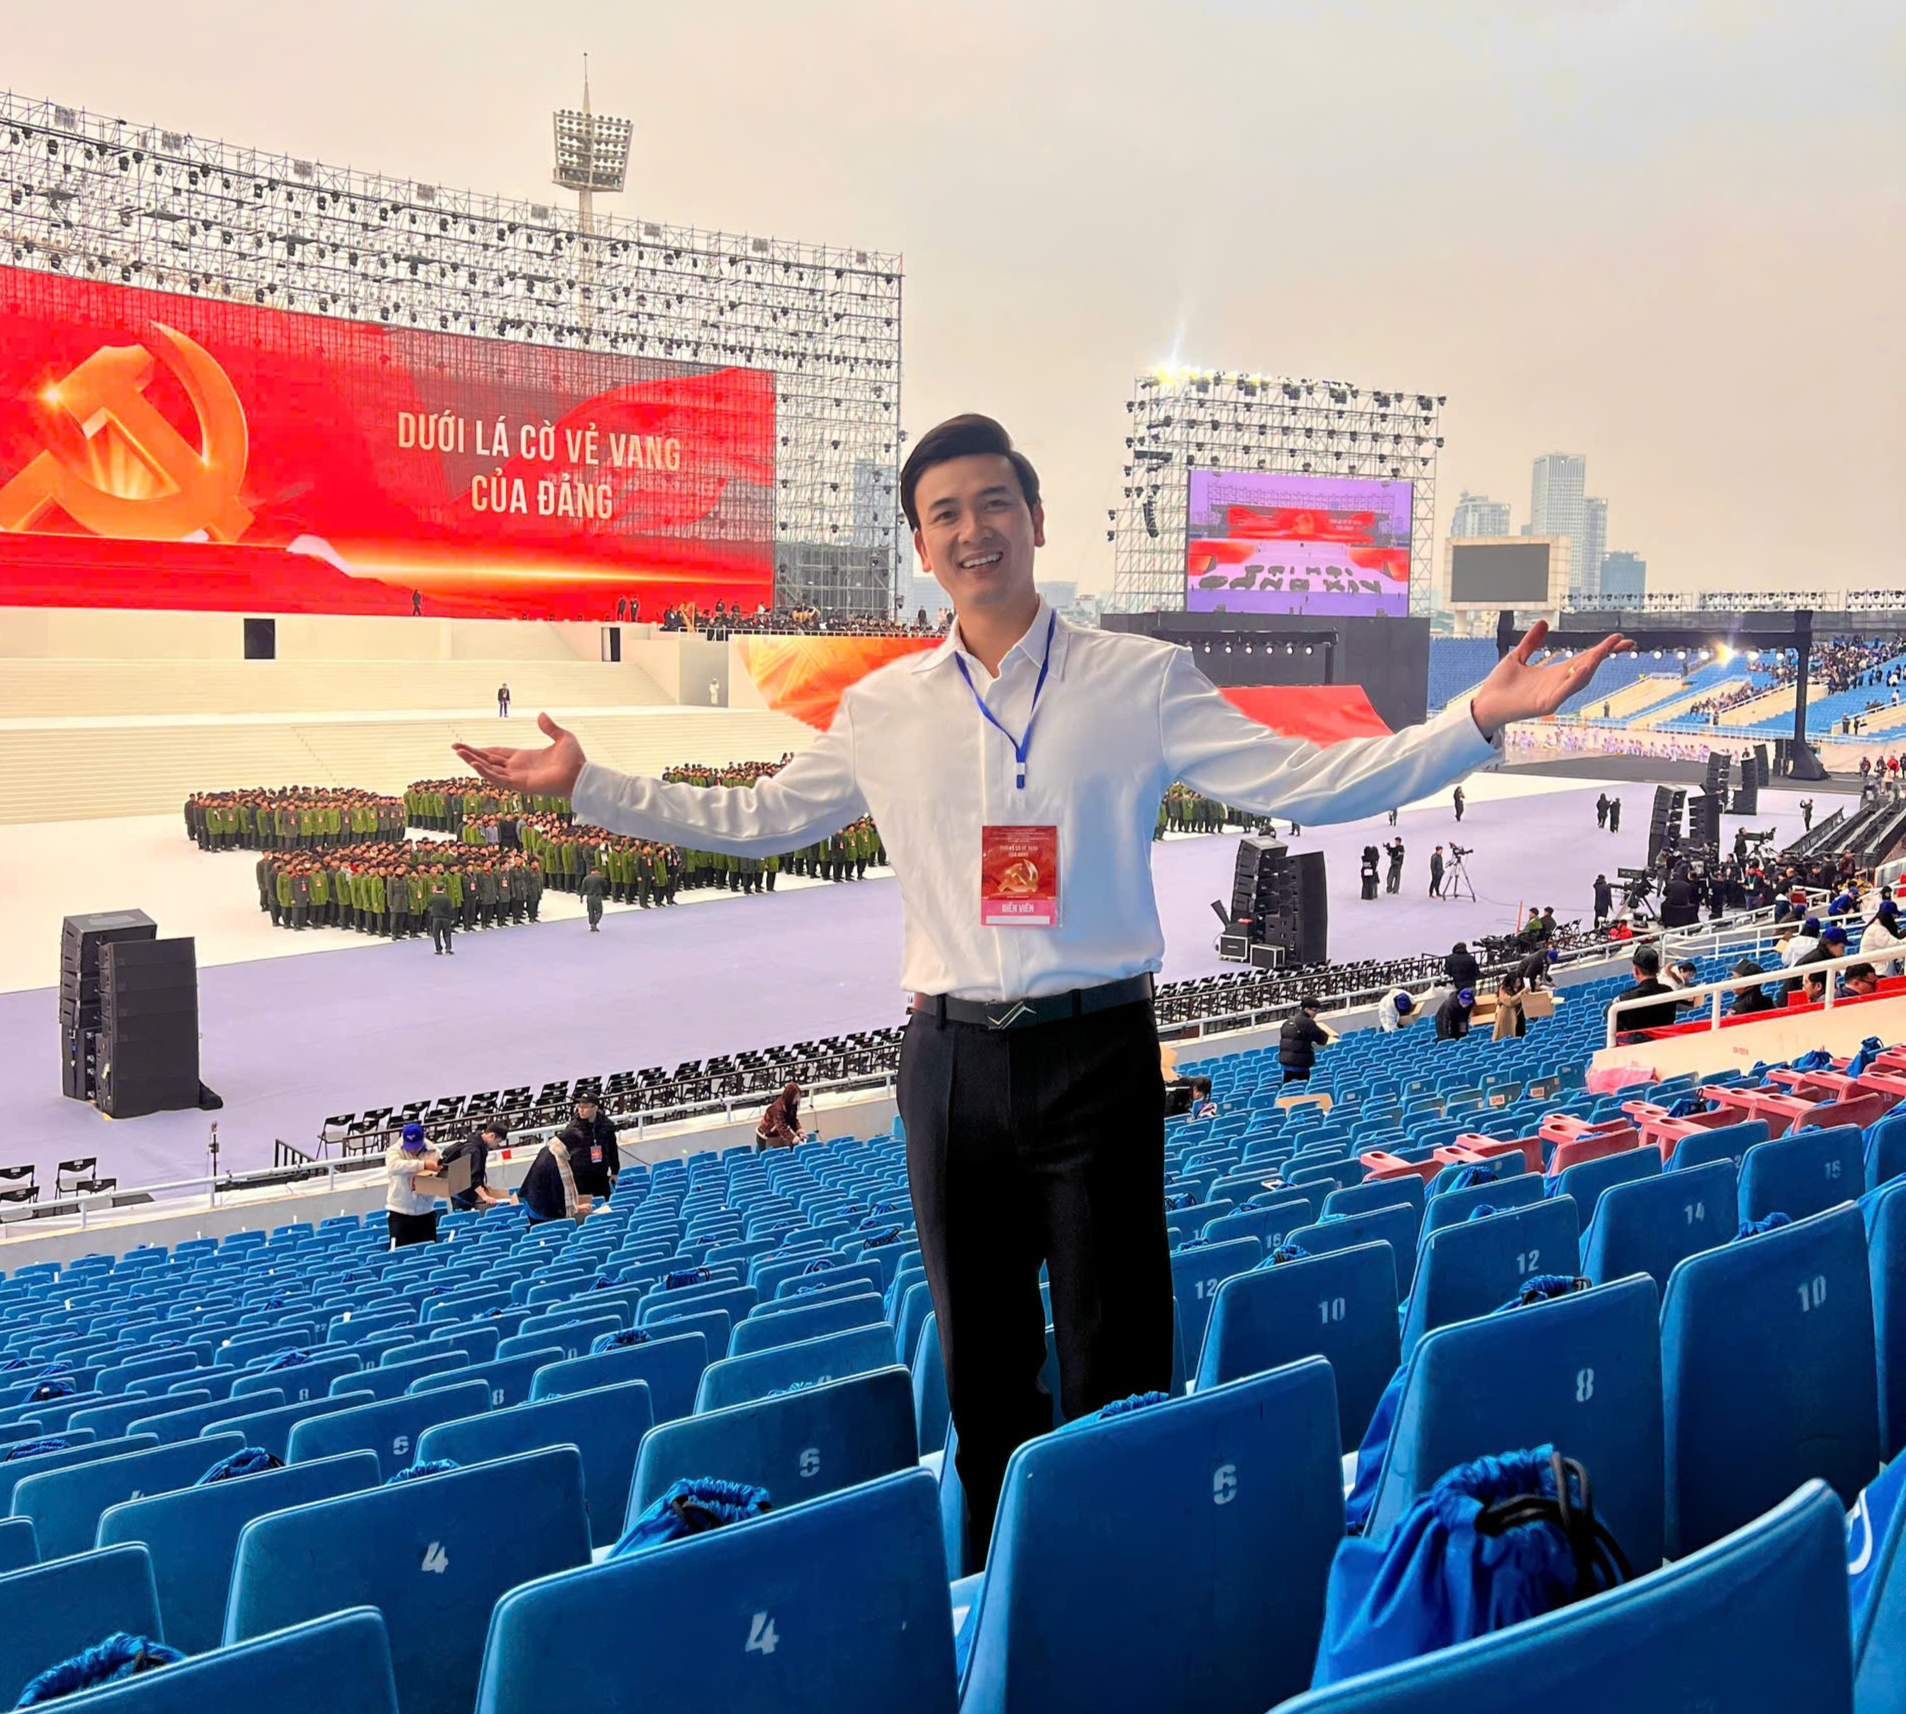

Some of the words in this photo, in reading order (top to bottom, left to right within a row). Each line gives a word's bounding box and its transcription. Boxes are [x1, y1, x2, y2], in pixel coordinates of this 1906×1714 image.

[398, 410, 464, 453] DƯỚI
[475, 415, 509, 457] LÁ
[520, 420, 556, 461] CỜ
[565, 422, 599, 465] VẺ
[609, 432, 681, 471] VANG
[471, 467, 528, 514] CỦA
[537, 473, 613, 520] ĐẢNG
[1684, 1201, 1706, 1225] 14
[1516, 1249, 1540, 1275] 12
[1195, 1278, 1218, 1300] 12
[1797, 1275, 1828, 1313] 10
[1318, 1297, 1346, 1324] 10
[491, 1388, 505, 1406] 8
[1576, 1368, 1595, 1403] 8
[393, 1435, 409, 1456] 6
[799, 1447, 820, 1478] 6
[1213, 1464, 1237, 1505] 6
[421, 1541, 449, 1574] 4
[745, 1611, 780, 1655] 4
